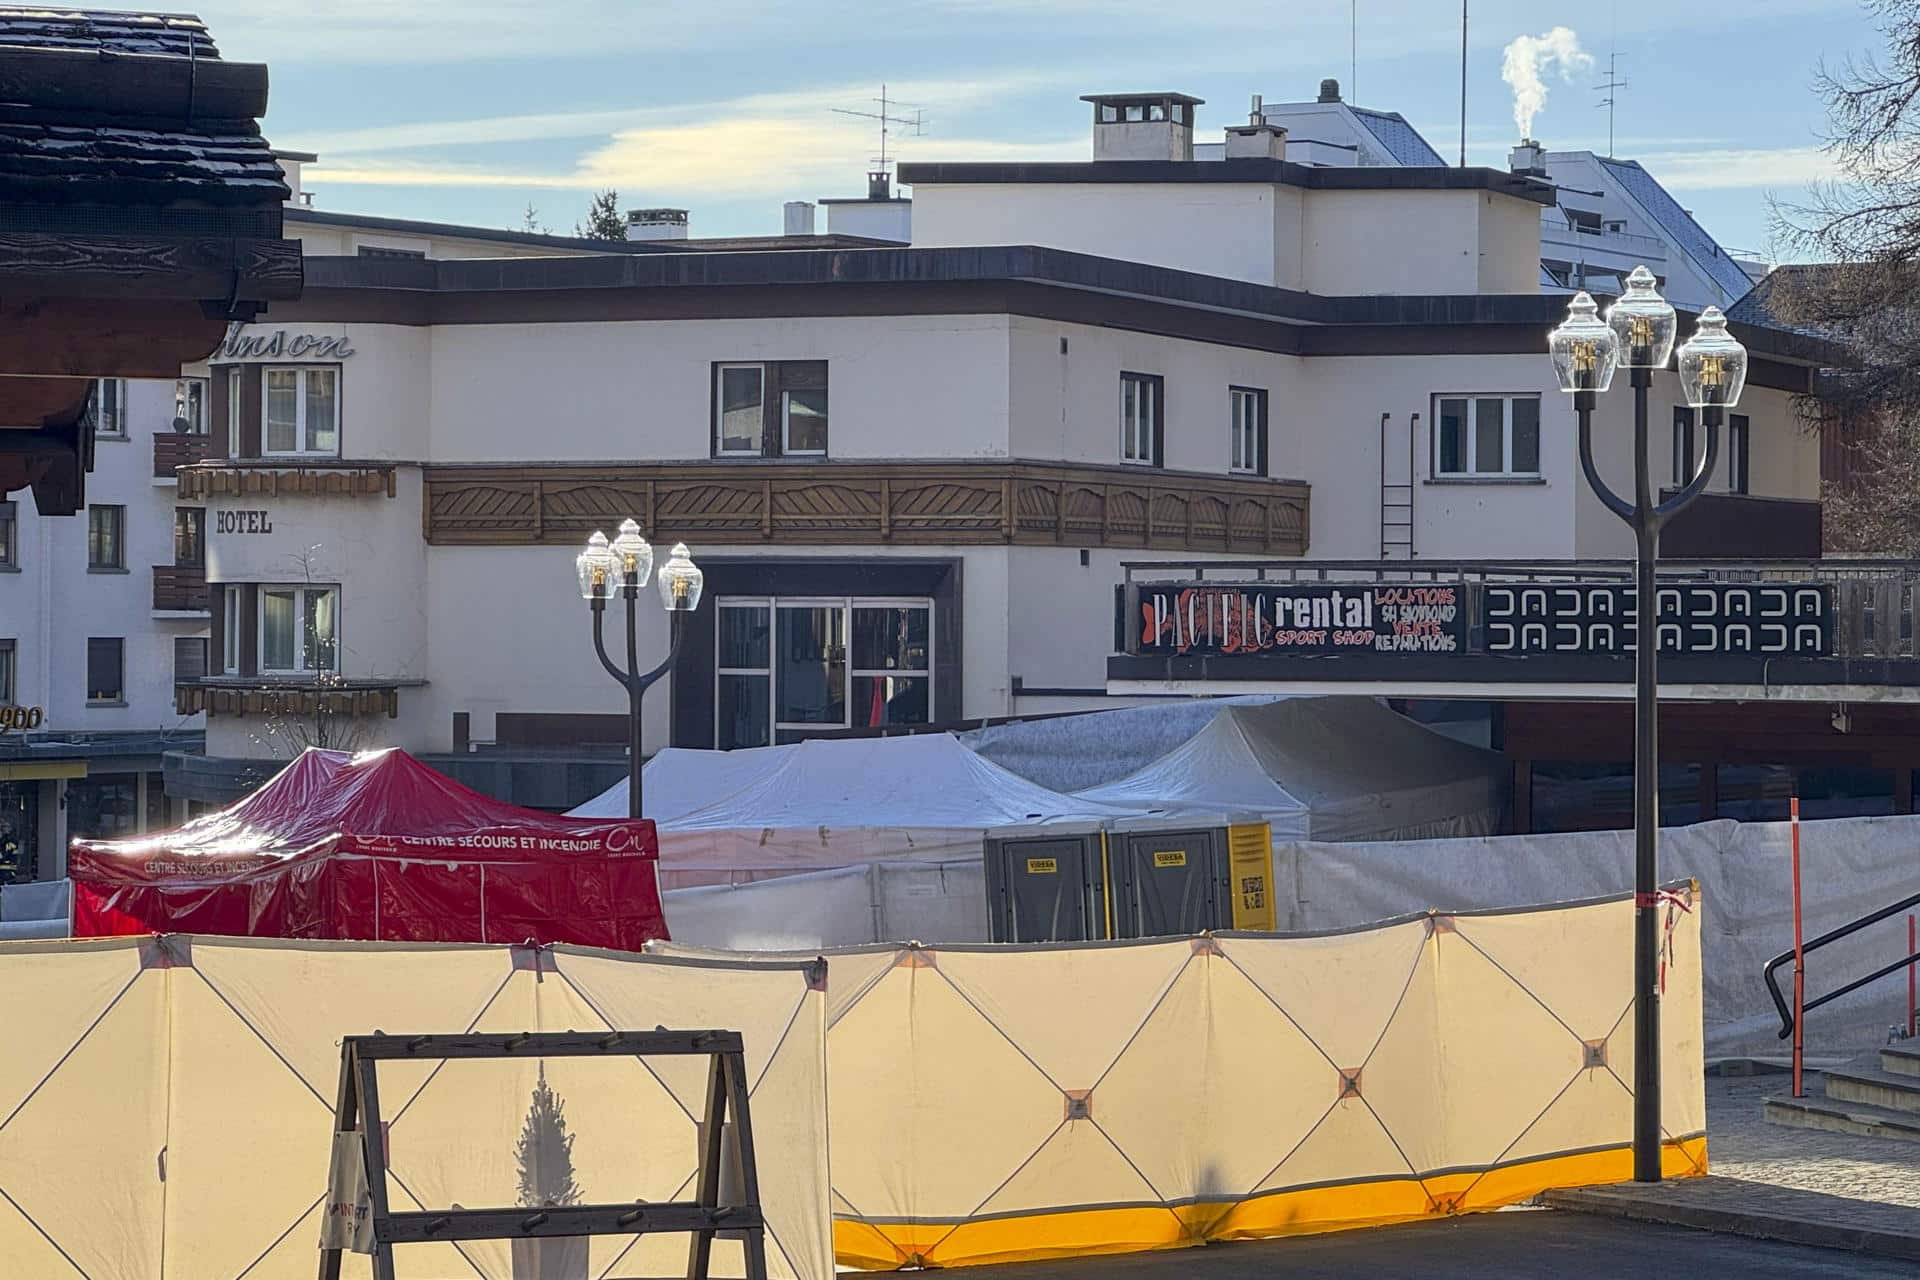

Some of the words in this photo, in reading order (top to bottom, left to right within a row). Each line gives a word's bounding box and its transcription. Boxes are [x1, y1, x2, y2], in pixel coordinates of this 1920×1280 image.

[217, 511, 272, 533] HOTEL
[1375, 588, 1455, 605] LOCATIONS
[1152, 593, 1268, 646] PACIFIC
[1275, 590, 1373, 628] rental
[1275, 630, 1327, 645] SPORT
[1332, 629, 1375, 645] SHOP
[1392, 621, 1441, 637] VENTE
[402, 836, 455, 847] CENTRE
[457, 836, 516, 849] SECOURS
[520, 837, 536, 849] ET
[539, 838, 601, 851] INCENDIE
[144, 862, 176, 874] CENTRE
